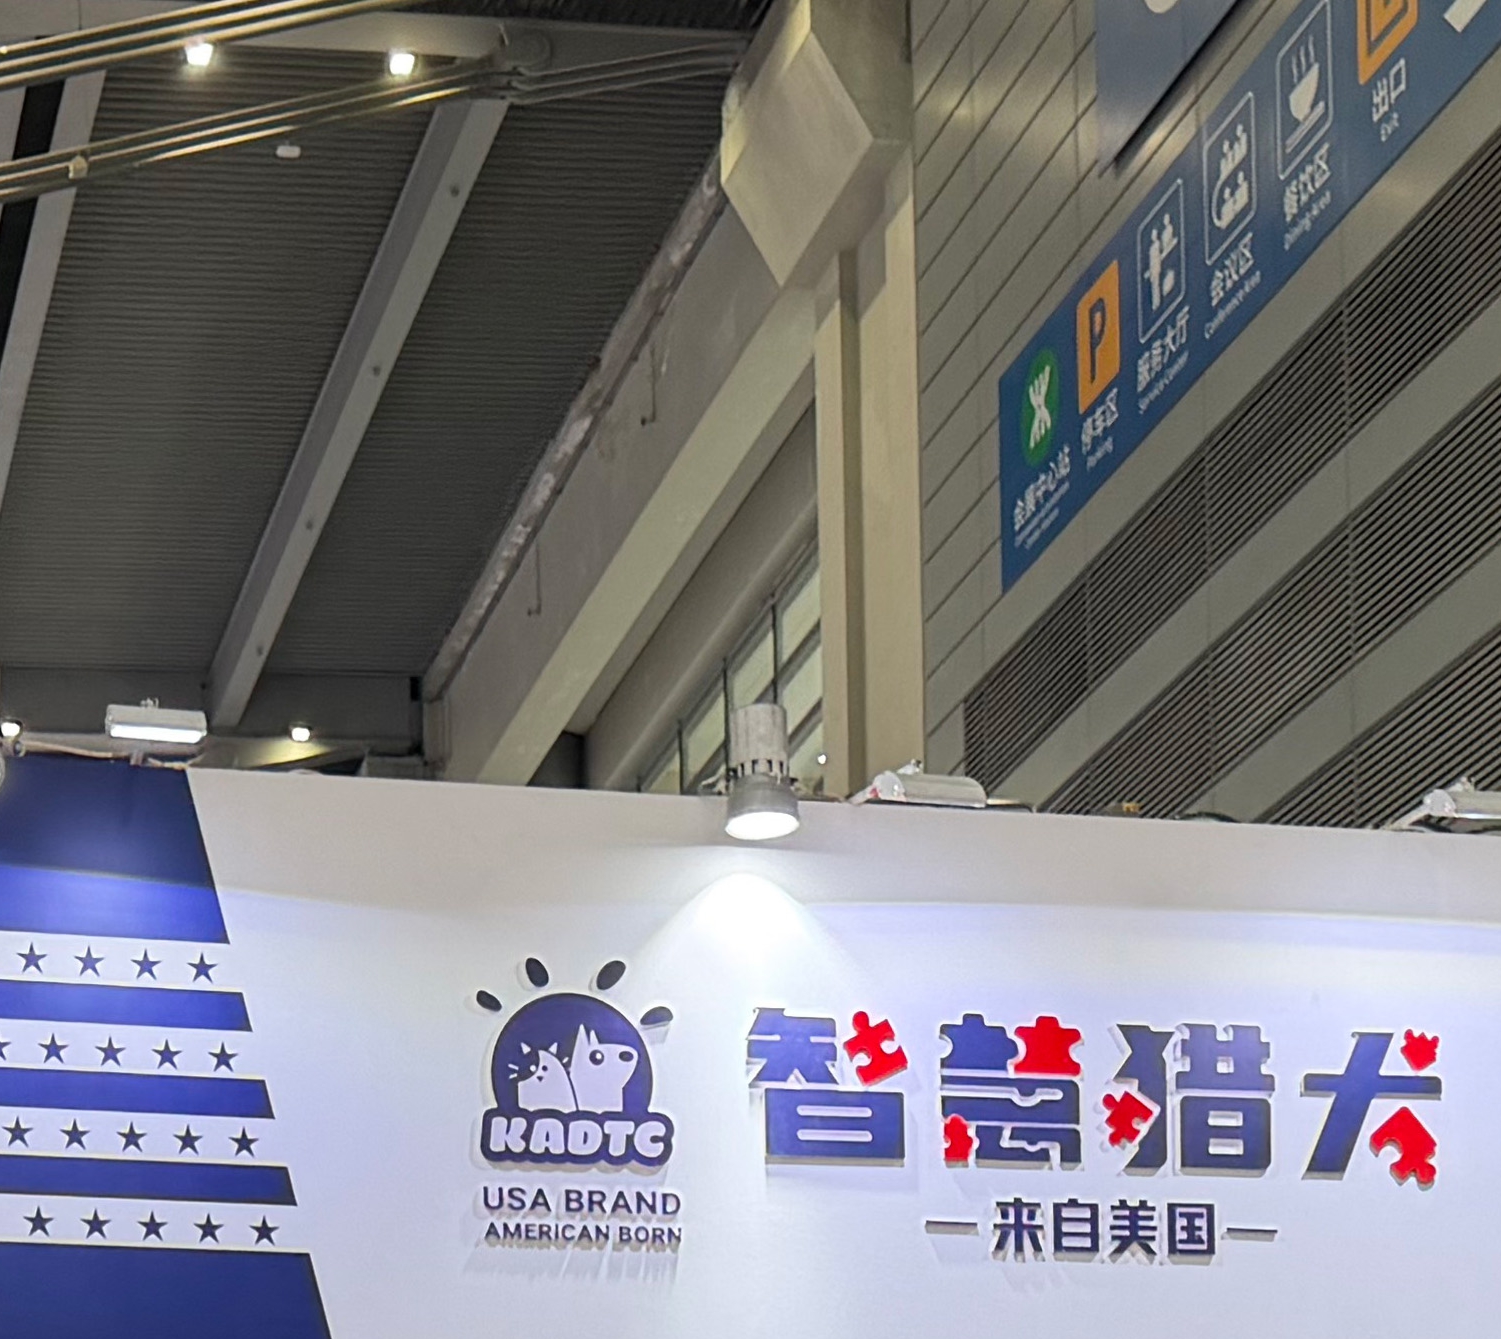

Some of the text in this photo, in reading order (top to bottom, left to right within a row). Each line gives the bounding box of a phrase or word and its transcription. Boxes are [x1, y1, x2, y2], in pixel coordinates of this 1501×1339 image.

[1372, 58, 1406, 122] 出口
[1283, 143, 1331, 223] 餐饮区
[1211, 232, 1254, 306] 会议区
[1137, 305, 1189, 392] 服务大厅
[1081, 387, 1119, 454] 停车区
[1013, 444, 1071, 531] 会展中心站
[746, 1007, 1444, 1188] 智慧猎犬
[488, 1113, 670, 1160] KADTC
[482, 1185, 682, 1217] USA BRAND
[484, 1221, 682, 1247] AMERICAN BORN
[992, 1198, 1217, 1258] 来自美国
